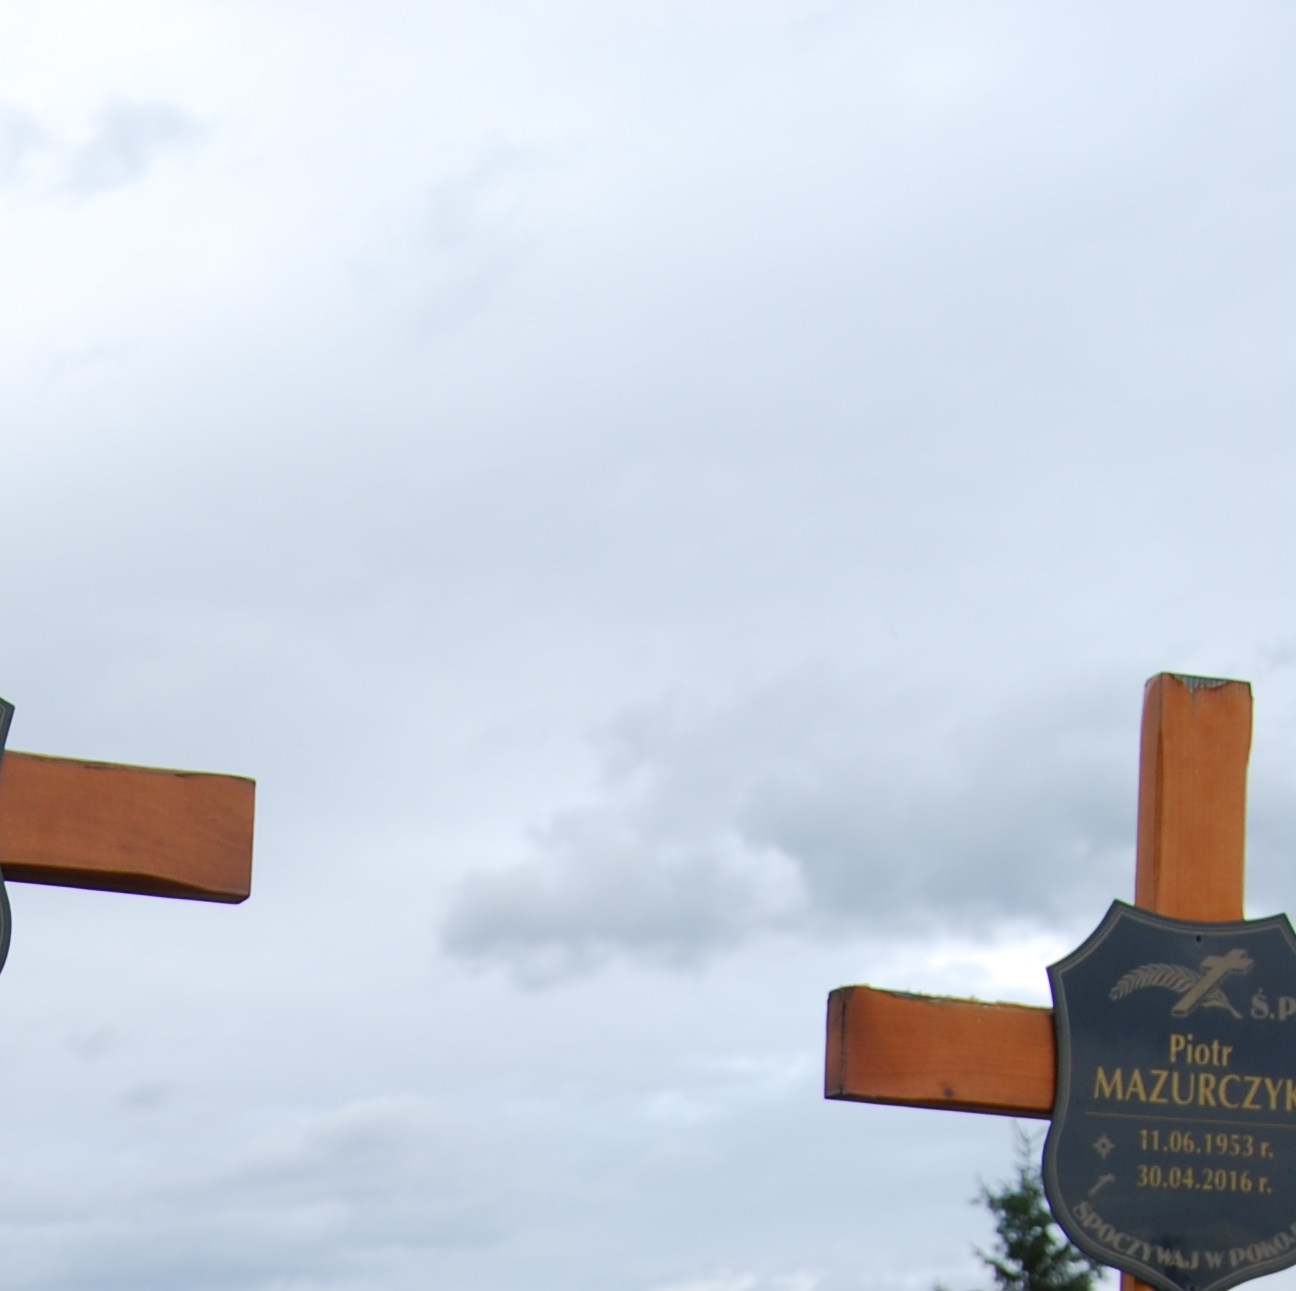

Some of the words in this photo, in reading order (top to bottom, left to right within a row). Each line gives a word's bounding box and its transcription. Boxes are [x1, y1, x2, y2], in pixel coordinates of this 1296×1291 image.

[1169, 1034, 1233, 1067] Piotr
[1140, 1130, 1254, 1159] 11.06.1953
[1260, 1141, 1274, 1159] r.
[1137, 1165, 1252, 1192] 30.04.2016
[1258, 1176, 1272, 1194] r.
[1073, 1201, 1200, 1269] SPOCZYWAJ
[1204, 1250, 1225, 1270] W
